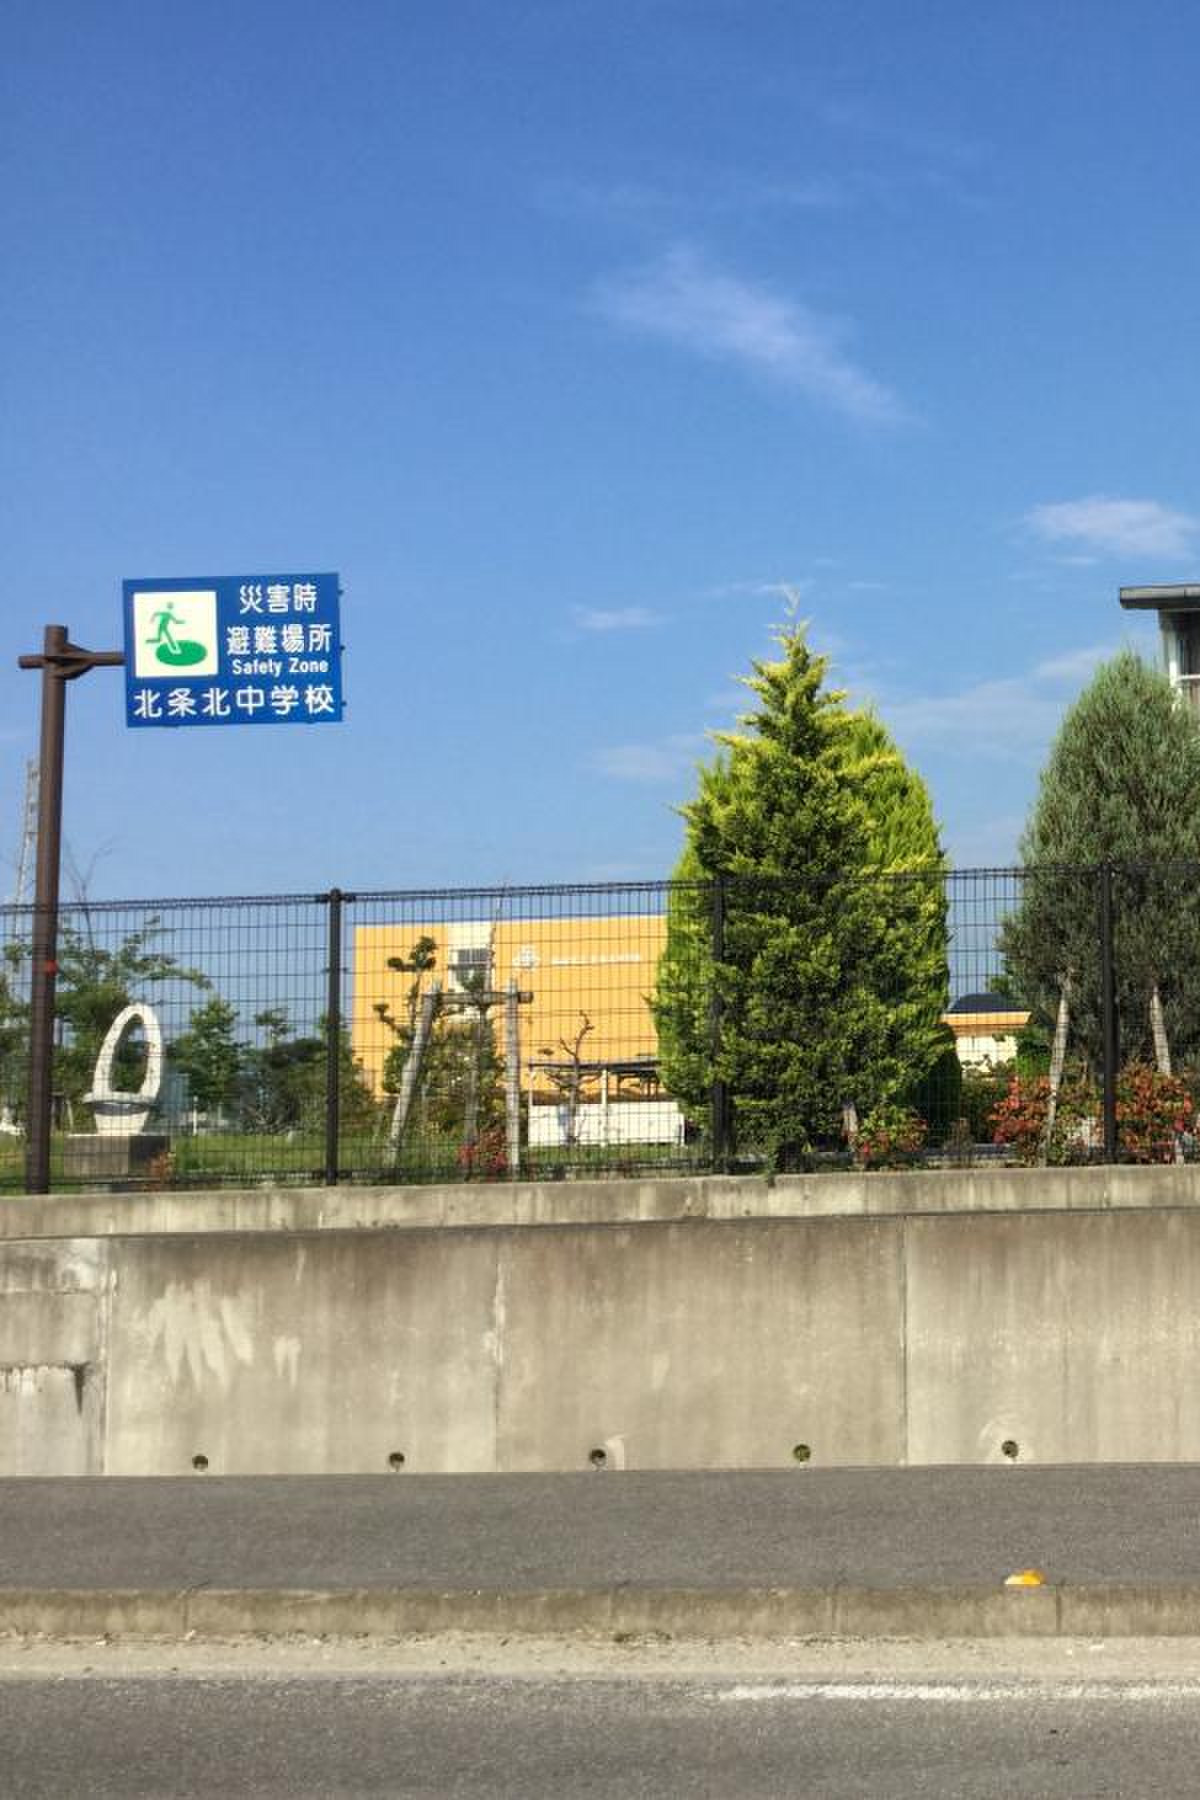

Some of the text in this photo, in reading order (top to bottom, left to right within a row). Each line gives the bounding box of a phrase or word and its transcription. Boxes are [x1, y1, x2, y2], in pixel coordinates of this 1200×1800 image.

[240, 584, 317, 614] 災害時
[226, 623, 332, 655] 避難場所
[233, 658, 329, 677] Safety Zone
[133, 683, 335, 718] 北条北中学校
